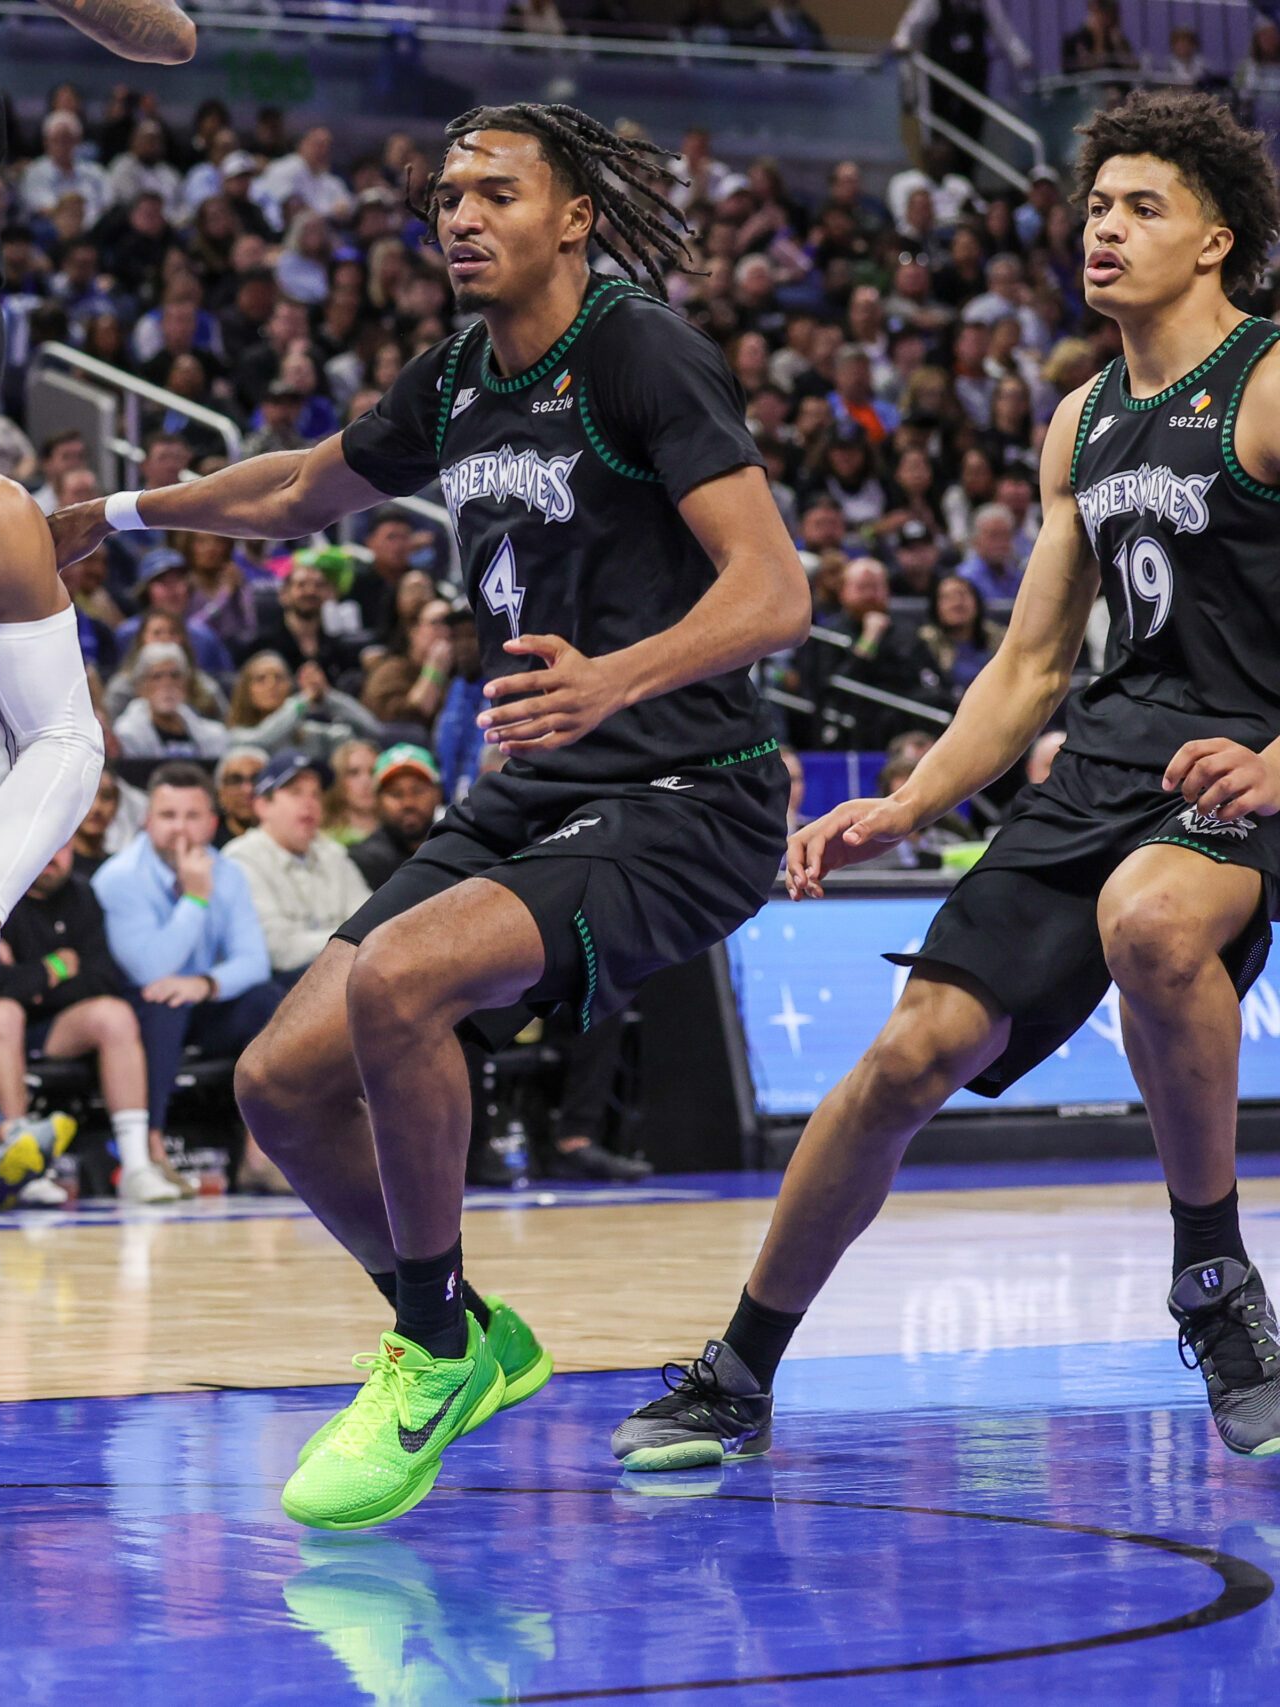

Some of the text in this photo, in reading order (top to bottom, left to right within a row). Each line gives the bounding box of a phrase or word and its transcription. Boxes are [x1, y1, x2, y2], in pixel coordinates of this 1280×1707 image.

[531, 394, 574, 414] sezzle
[1168, 414, 1218, 429] sezzle
[479, 533, 526, 641] 4
[1112, 536, 1173, 640] 19
